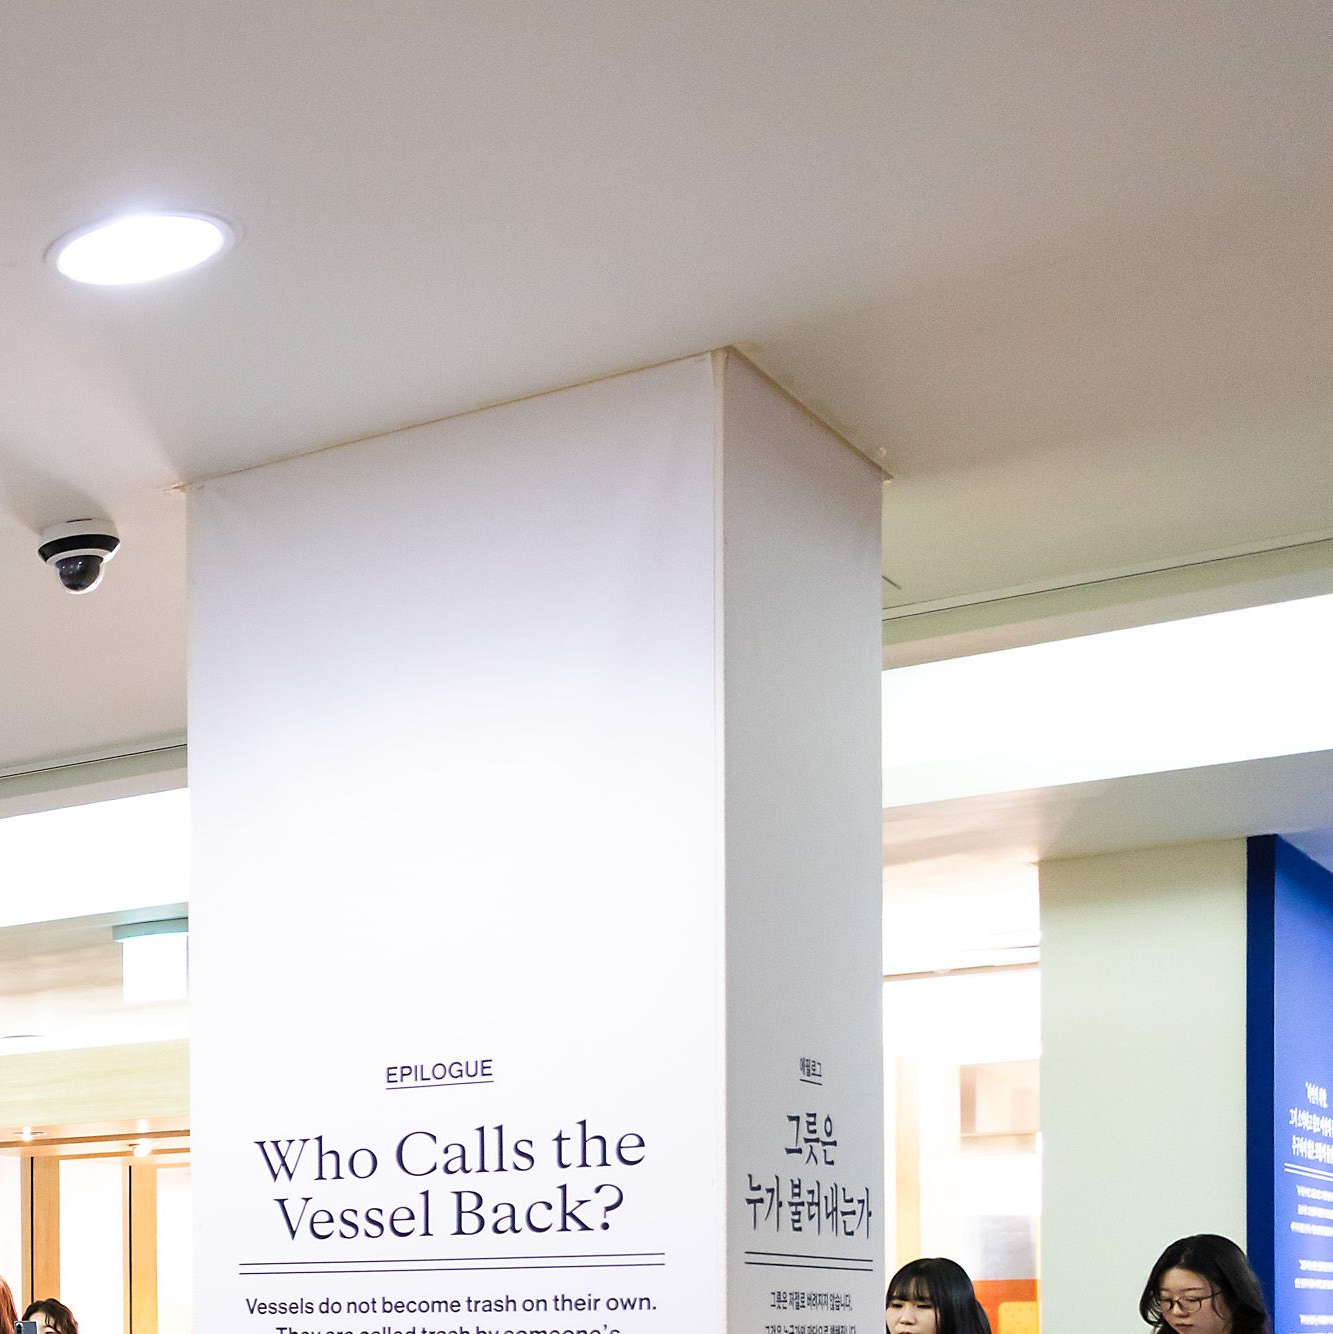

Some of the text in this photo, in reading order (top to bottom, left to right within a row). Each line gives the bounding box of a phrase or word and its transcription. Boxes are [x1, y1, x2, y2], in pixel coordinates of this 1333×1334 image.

[385, 1059, 494, 1084] EPILOGUE
[252, 1118, 646, 1183] Who Calls the
[785, 1112, 837, 1166] 그릇은
[272, 1183, 624, 1241] Vessel Back?
[745, 1174, 872, 1239] 누가 불러내는가
[245, 1293, 657, 1315] Vessels do not become trash on their own.
[770, 1291, 787, 1310] 그릇은
